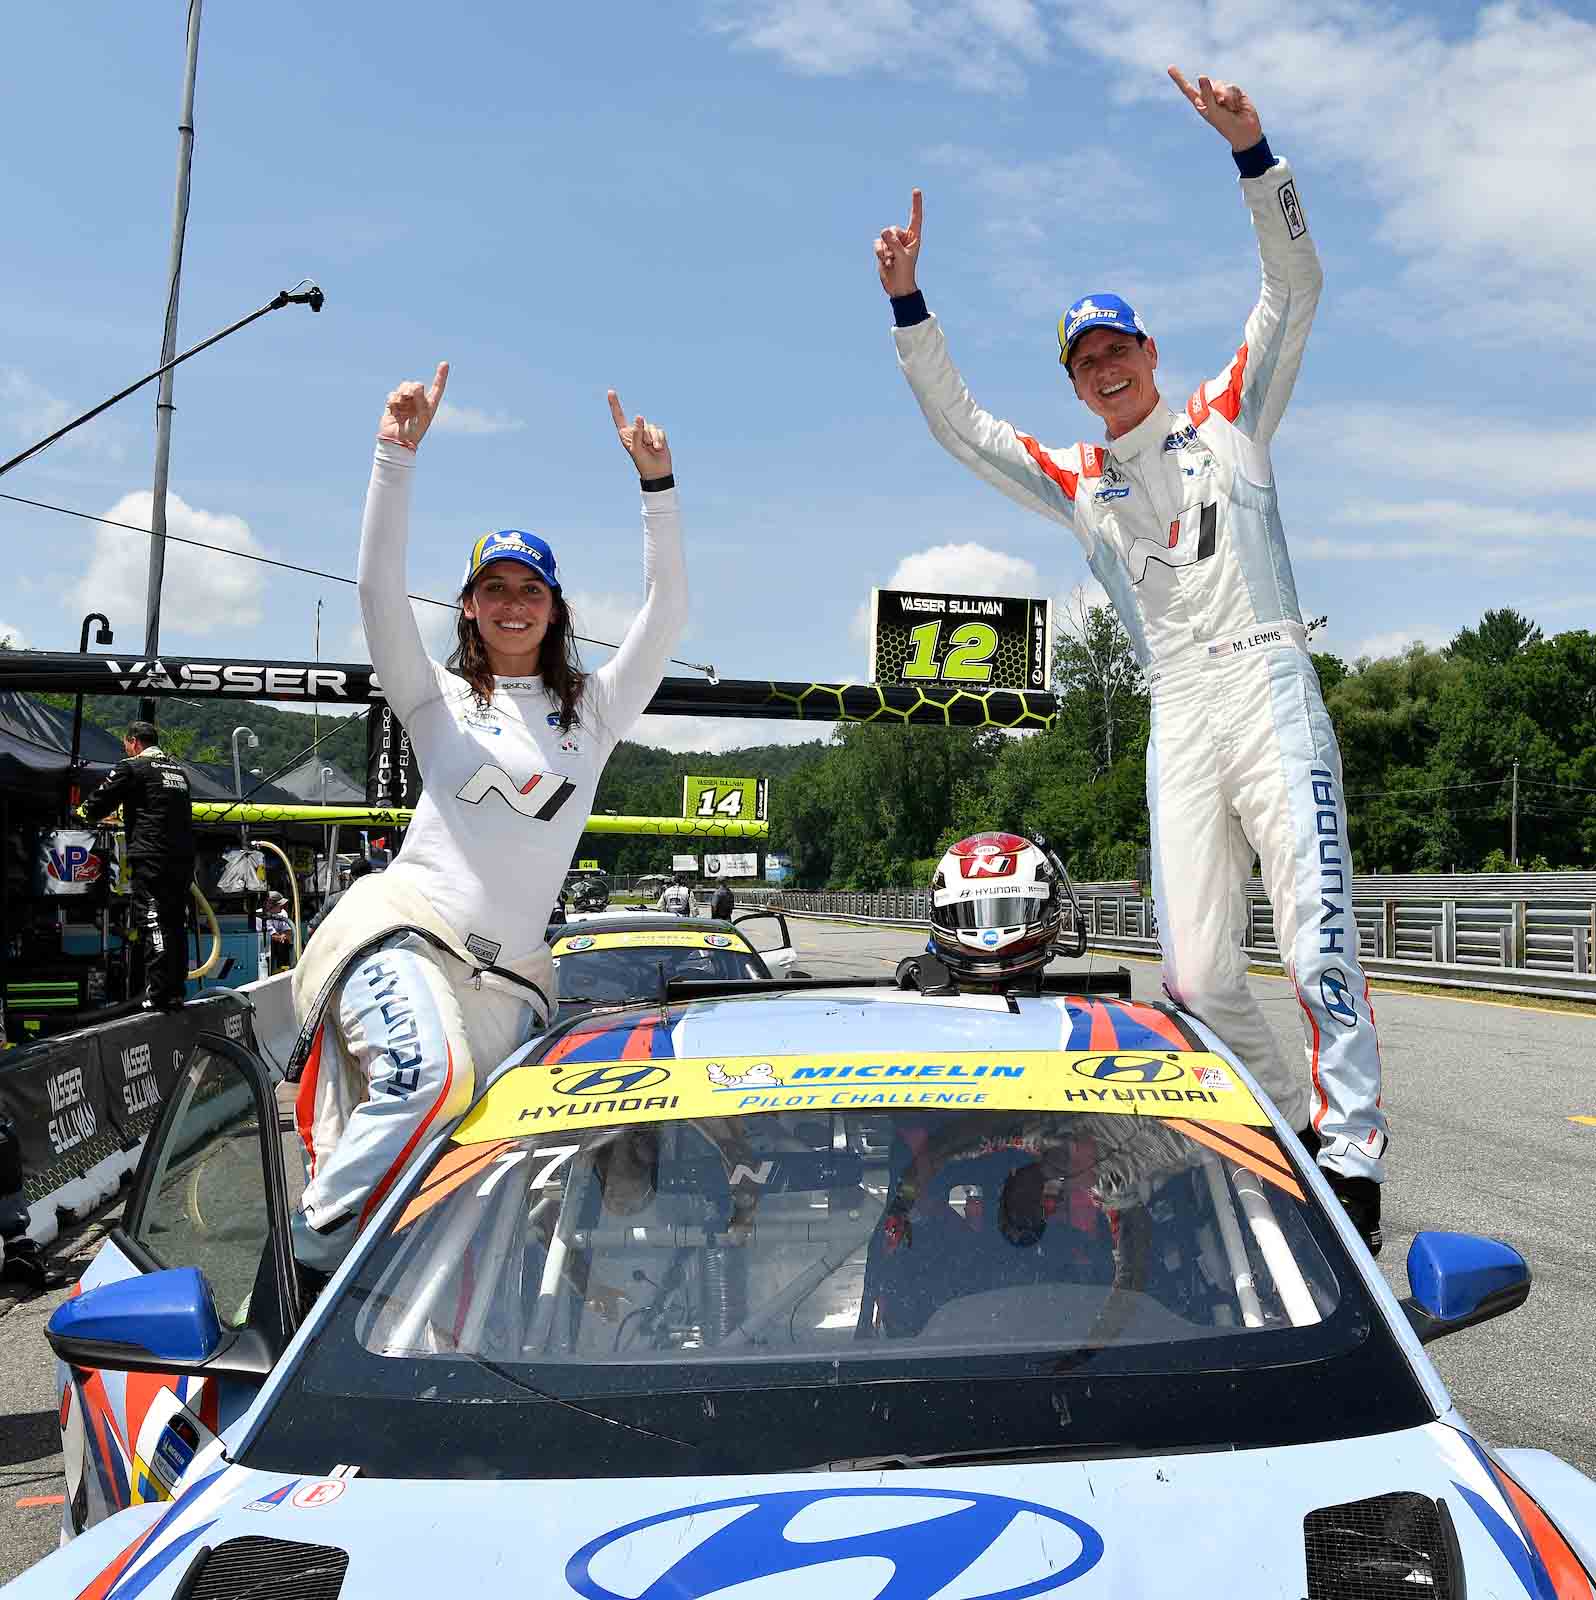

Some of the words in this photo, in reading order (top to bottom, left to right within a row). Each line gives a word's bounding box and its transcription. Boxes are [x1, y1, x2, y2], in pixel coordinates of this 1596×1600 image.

[900, 596, 945, 613] VASSER
[949, 601, 1003, 617] SULLIVAN
[902, 620, 999, 682] 12
[1232, 640, 1246, 652] M.
[1248, 630, 1281, 647] LEWIS
[106, 660, 348, 696] VASSER
[383, 706, 391, 749] EURO
[400, 729, 410, 766] EURO
[696, 787, 744, 818] 14
[47, 846, 89, 882] VP
[1310, 769, 1344, 954] HYUNDAI
[975, 886, 1021, 896] HYUNDAI
[120, 1043, 153, 1080] VASSER
[791, 1065, 1025, 1079] MICHELIN
[46, 1067, 86, 1117] VASSER
[123, 1073, 162, 1115] SULLIVAN
[518, 1096, 680, 1121] HYUNDAI
[738, 1095, 822, 1108] PILOT
[831, 1091, 989, 1105] CHALLENGE
[1064, 1089, 1218, 1103] HYUNDAI
[48, 1102, 98, 1154] SULLIVAN
[476, 1145, 580, 1197] 77
[304, 1485, 336, 1502] E
